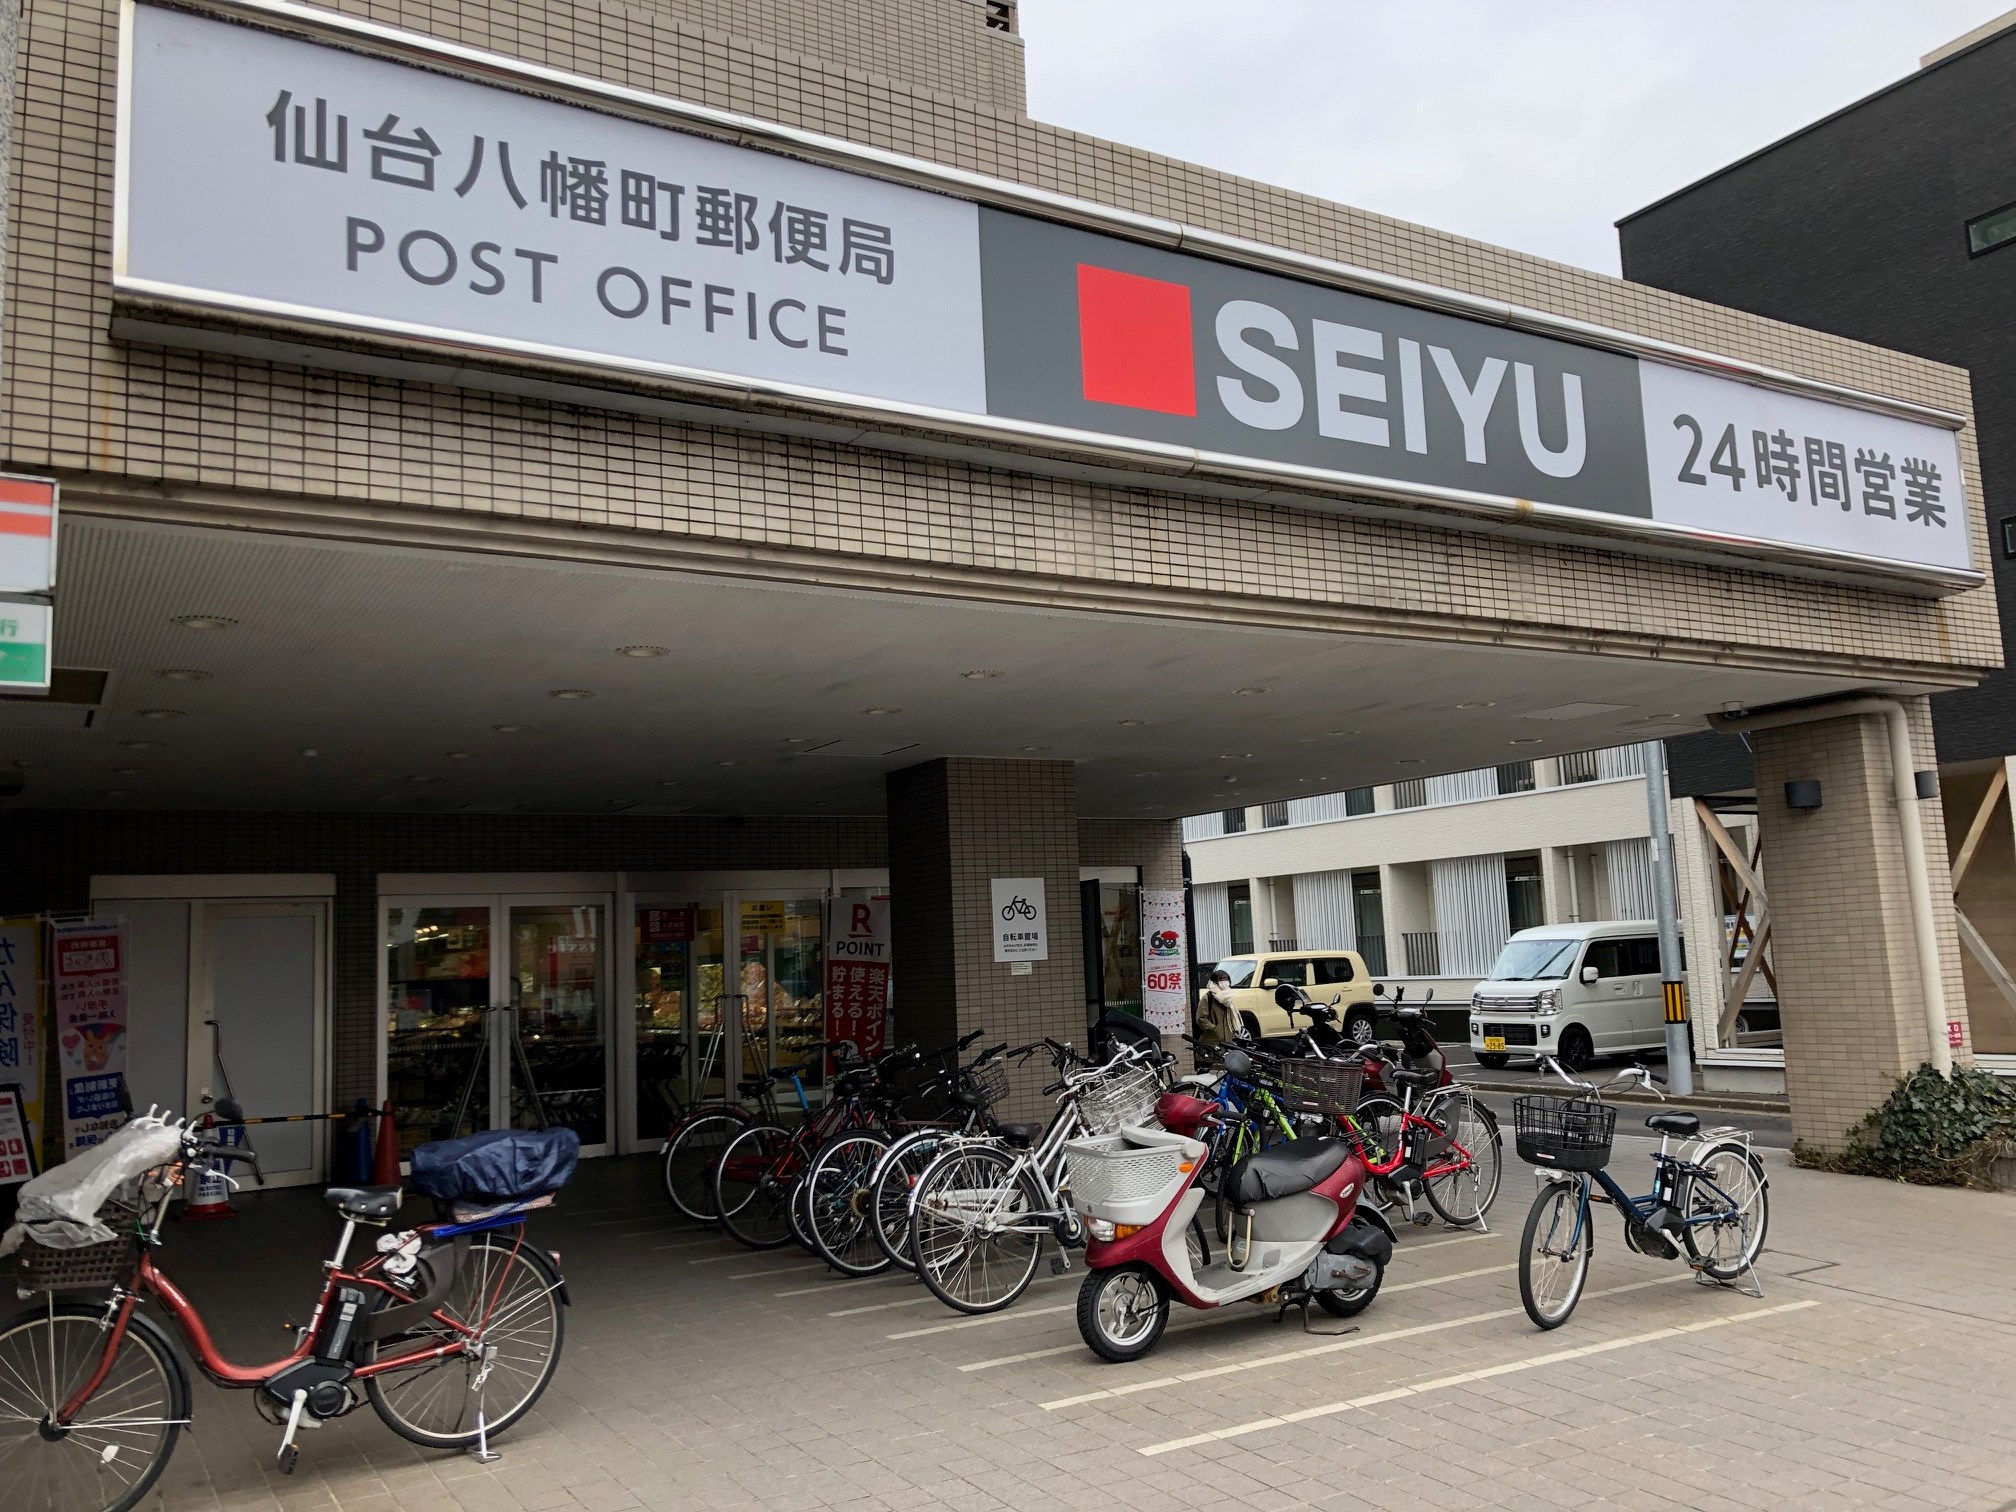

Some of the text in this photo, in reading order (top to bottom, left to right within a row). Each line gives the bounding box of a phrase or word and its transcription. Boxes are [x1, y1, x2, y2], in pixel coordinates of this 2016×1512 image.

[265, 89, 897, 287] 仙台八幡町郵便局
[345, 215, 850, 357] POST OFFICE
[1214, 297, 1588, 479] SEIYU
[1671, 412, 1950, 529] 24時間営業
[836, 940, 886, 957] POINT
[851, 902, 873, 933] R
[1002, 932, 1039, 942] 自転車置場
[864, 967, 887, 1059] 楽天ポイン
[1147, 972, 1182, 991] 60祭
